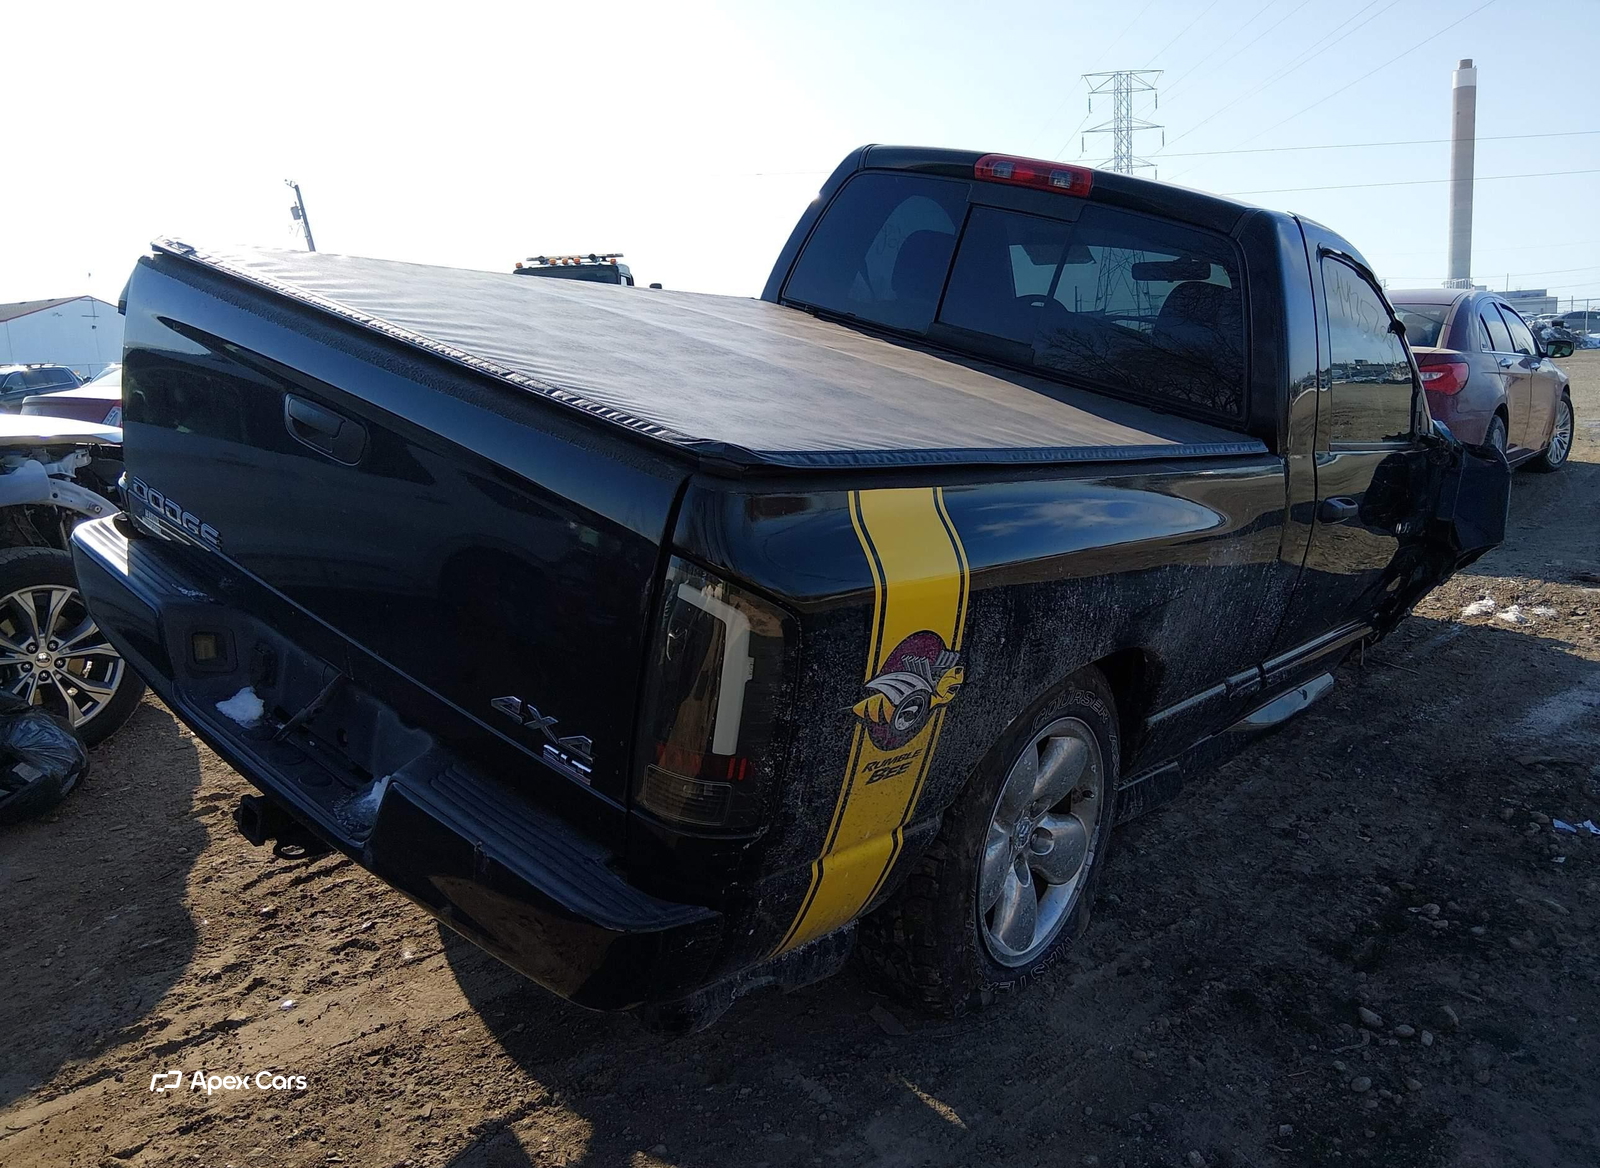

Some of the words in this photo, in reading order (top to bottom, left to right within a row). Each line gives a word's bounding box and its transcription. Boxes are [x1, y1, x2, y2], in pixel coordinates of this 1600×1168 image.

[132, 475, 222, 550] DODGE
[1031, 689, 1111, 735] COURSER
[861, 748, 924, 774] RUMBLE
[864, 761, 914, 786] BEE
